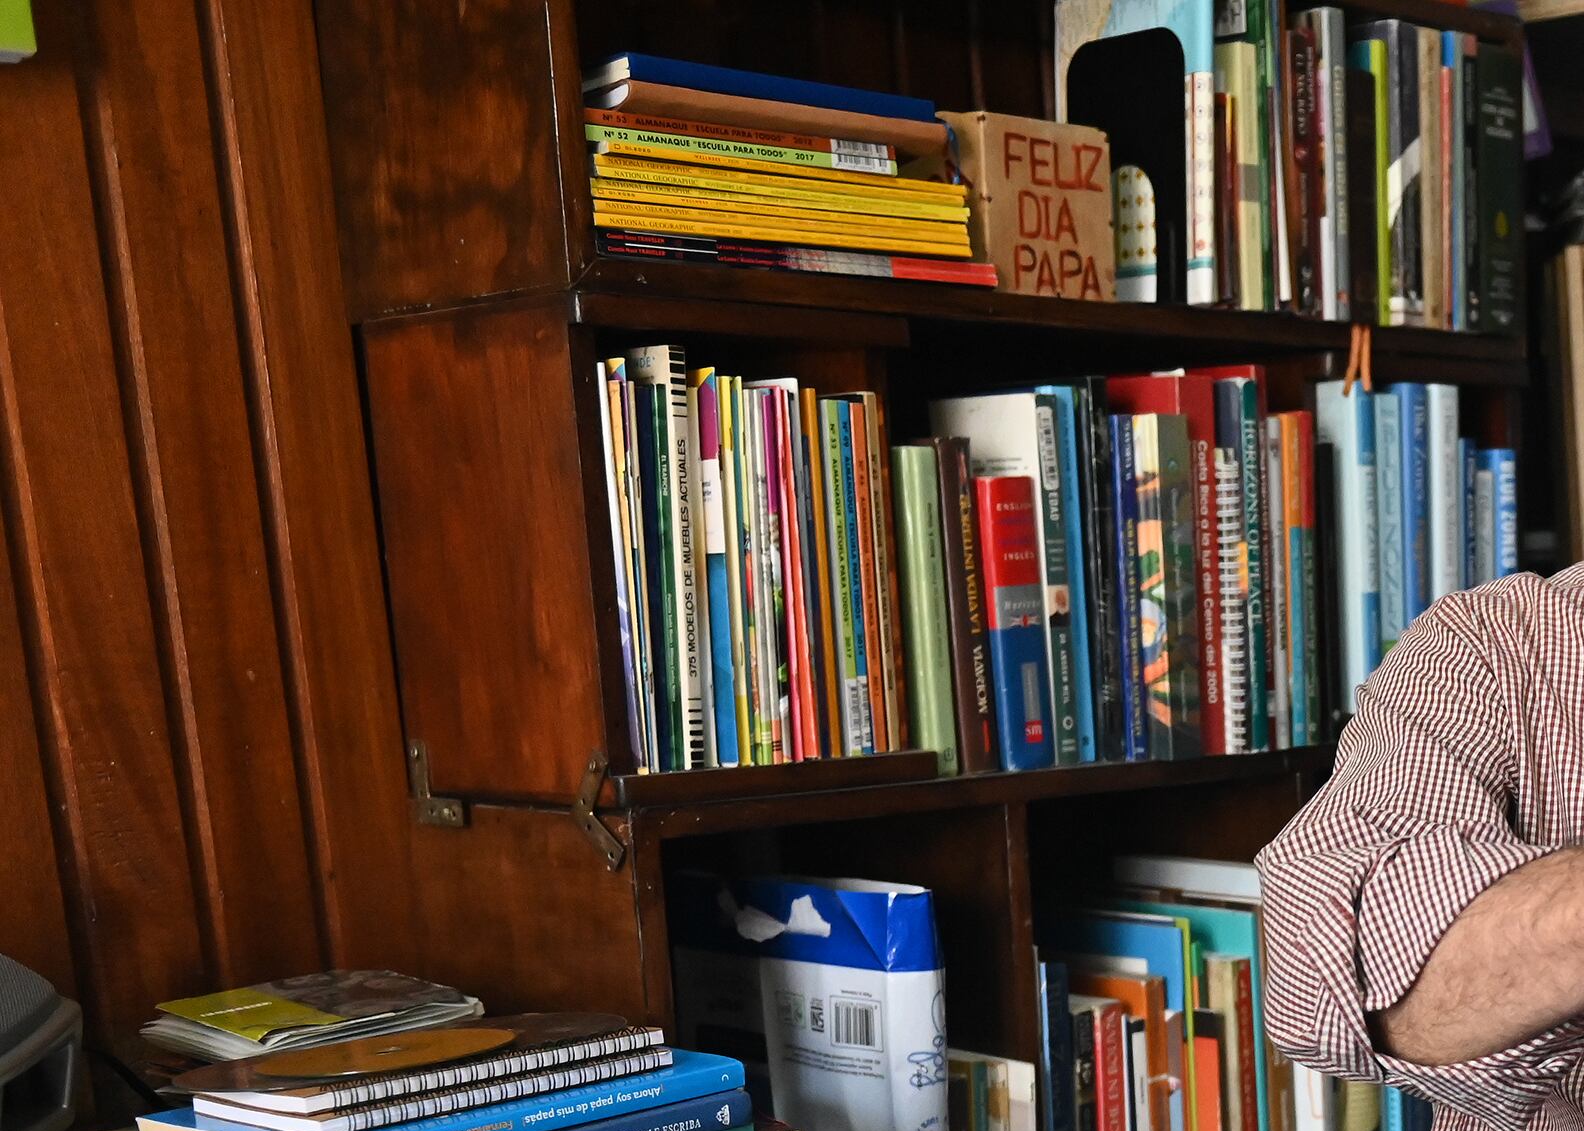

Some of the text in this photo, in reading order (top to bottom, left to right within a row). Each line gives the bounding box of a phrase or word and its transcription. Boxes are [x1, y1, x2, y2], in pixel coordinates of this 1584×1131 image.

[616, 115, 627, 123] 53
[635, 118, 688, 130] ALMANAQUE
[732, 129, 752, 138] PARA
[618, 132, 628, 140] 52
[637, 135, 690, 147] ALMANAQUE
[733, 145, 754, 154] PARA
[795, 153, 814, 161] 2017
[1004, 132, 1103, 192] FELIZ
[614, 170, 698, 186] NATIONAL GEOGRAPHIC
[609, 218, 696, 232] NATIONAL GEOGRAPHIC
[1018, 190, 1078, 244] DIA
[1014, 244, 1104, 300] PAPA
[1198, 441, 1210, 481] Costa
[1048, 492, 1060, 521] EDAD
[1200, 484, 1210, 516] Rica
[1501, 461, 1518, 568] BLUE ZONES
[1244, 418, 1262, 625] HORIZONS OF PEACE
[677, 438, 698, 678] 375 MODELOS DE MUEBLES ACTUALES
[1202, 550, 1212, 570] luz
[966, 573, 979, 613] VIDA
[1203, 572, 1214, 594] del
[970, 612, 981, 635] LA
[1204, 598, 1216, 641] Censo
[1206, 645, 1218, 667] del
[973, 644, 988, 714] MORAVIA
[1207, 671, 1218, 705] 2000
[576, 1102, 589, 1113] de
[591, 1096, 614, 1114] papá
[616, 1092, 632, 1104] soy
